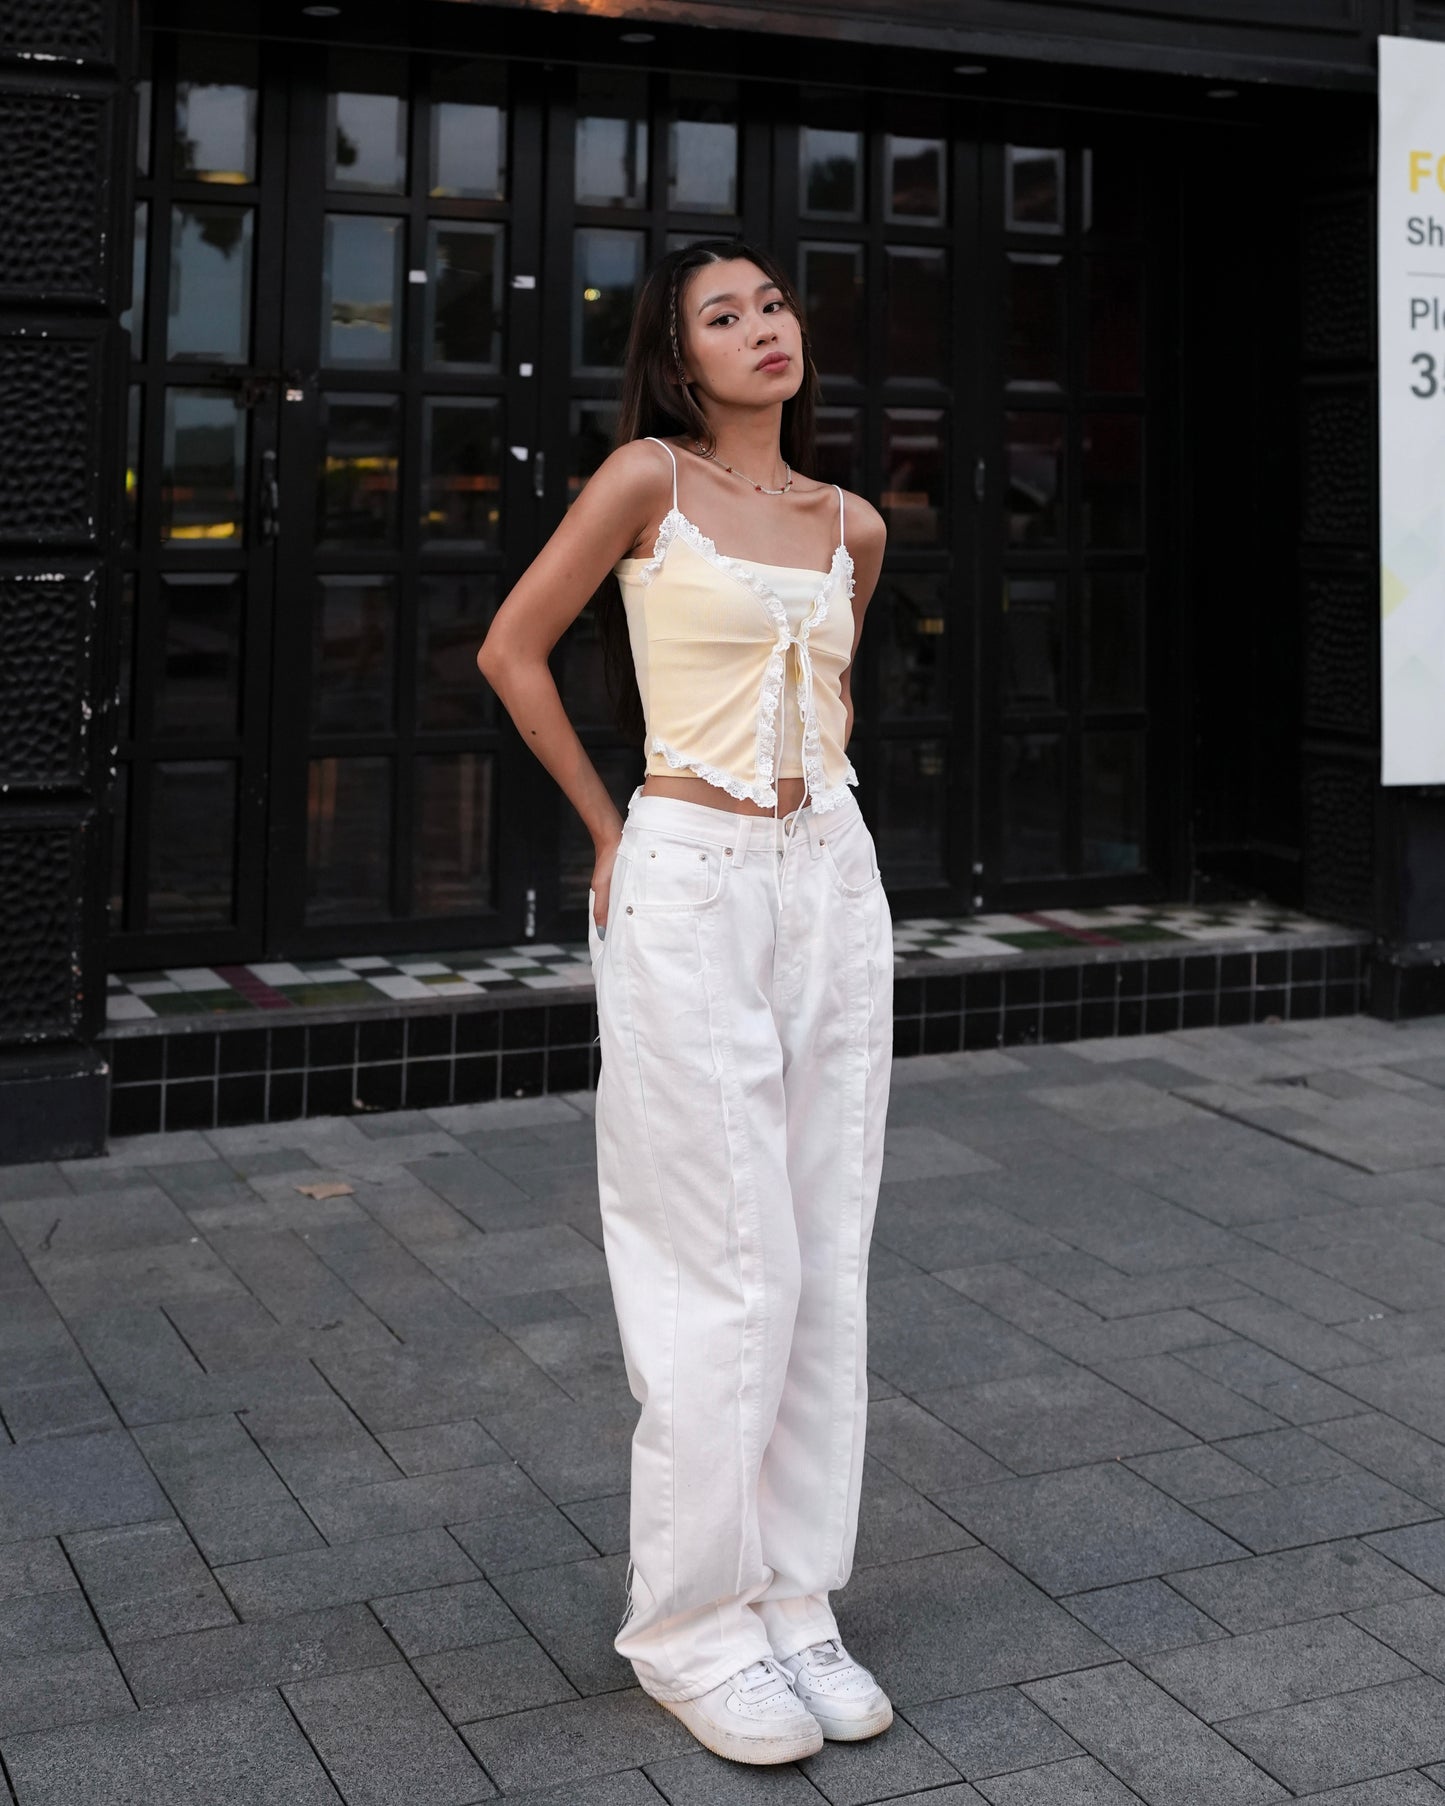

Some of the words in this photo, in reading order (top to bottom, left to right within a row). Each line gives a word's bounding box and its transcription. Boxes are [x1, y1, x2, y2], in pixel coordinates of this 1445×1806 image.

[1409, 151, 1445, 194] F
[1411, 297, 1445, 331] Pl
[1410, 352, 1445, 399] 3
